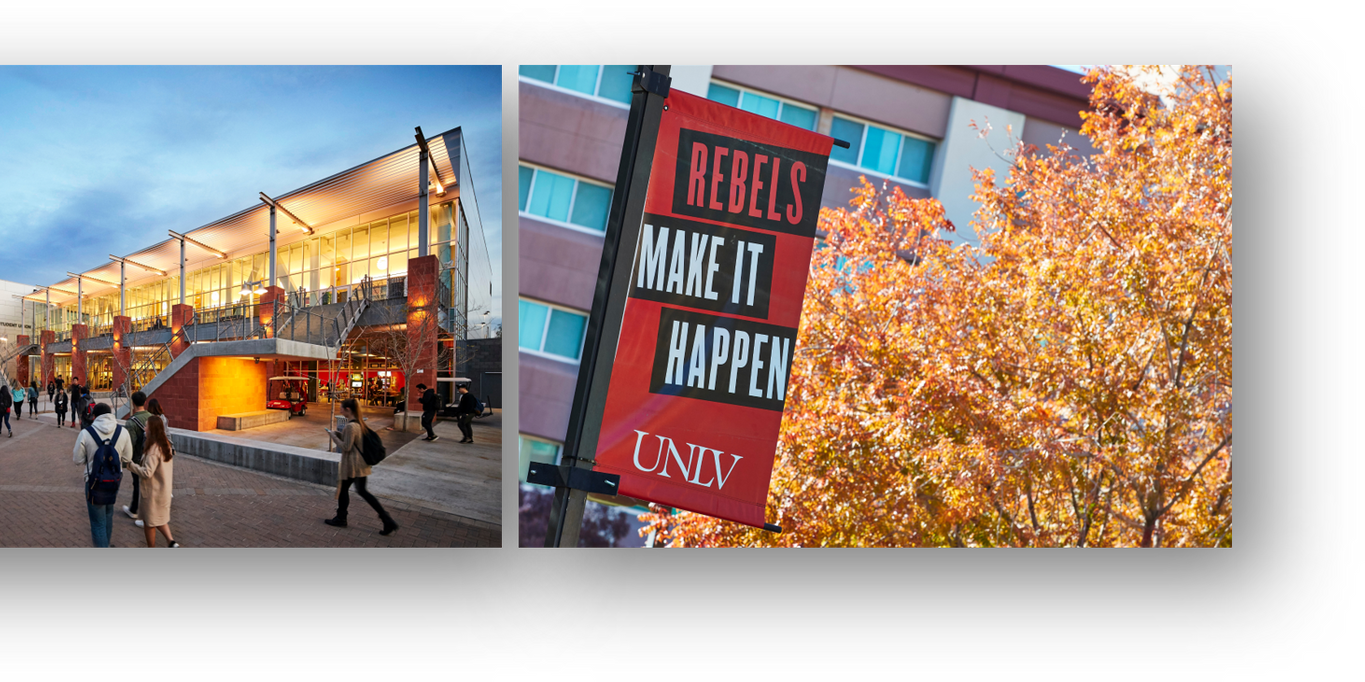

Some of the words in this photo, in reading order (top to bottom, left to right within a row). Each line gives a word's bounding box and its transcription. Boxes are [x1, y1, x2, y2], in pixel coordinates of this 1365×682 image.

[686, 141, 807, 225] REBELS
[636, 223, 725, 301] MAKE
[731, 240, 764, 306] IT
[664, 320, 790, 401] HAPPEN
[632, 429, 744, 490] UNLV
